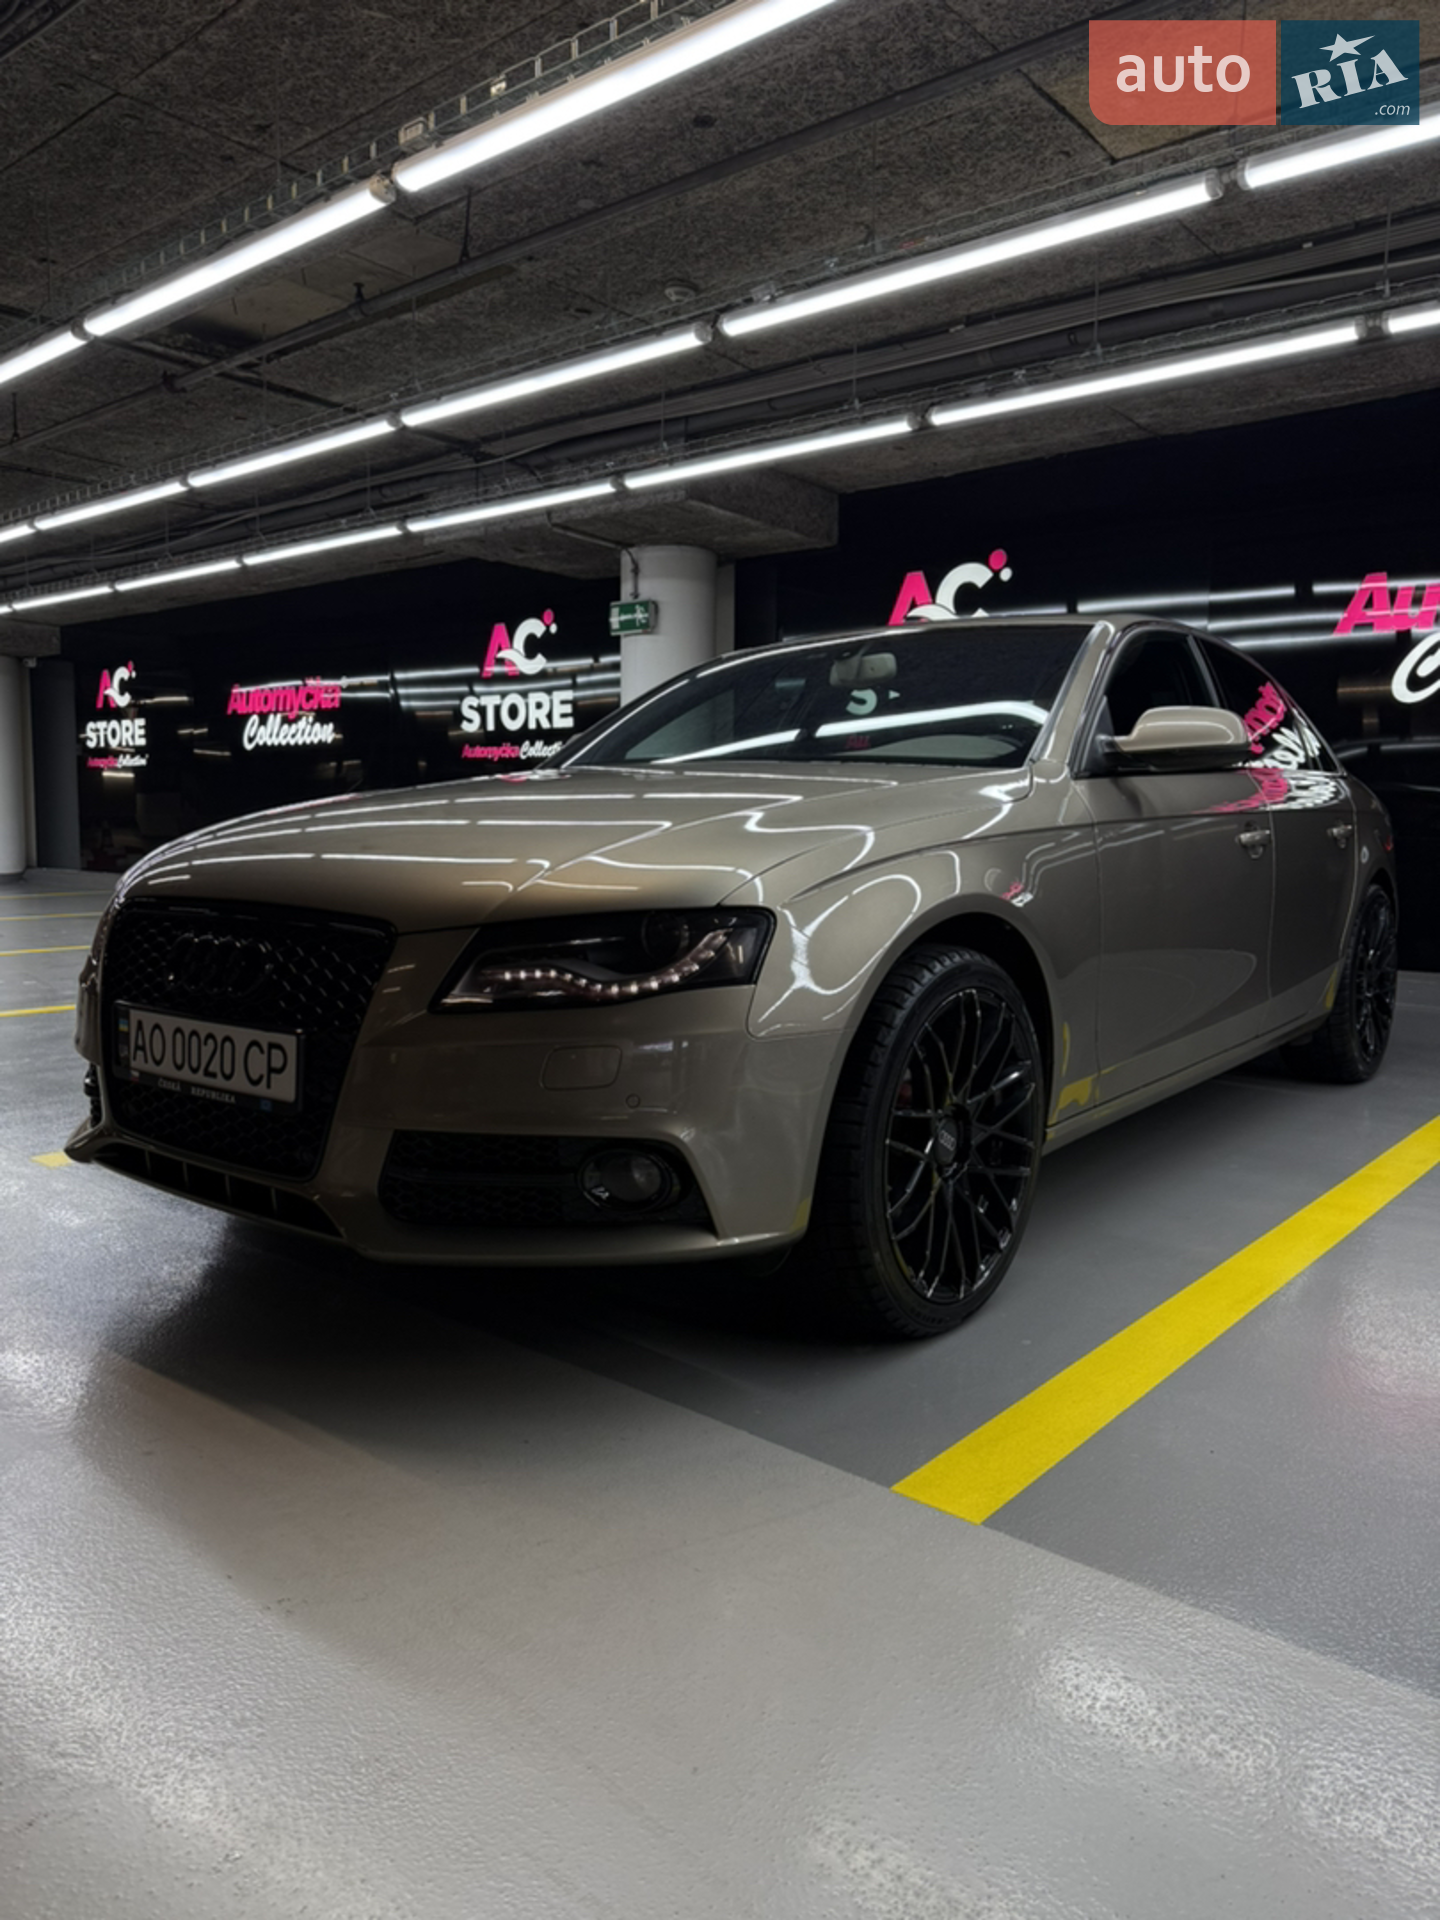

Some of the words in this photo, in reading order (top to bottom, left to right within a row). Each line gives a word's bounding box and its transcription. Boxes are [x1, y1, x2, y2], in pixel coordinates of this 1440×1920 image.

[242, 713, 335, 751] Collection
[459, 689, 575, 734] STORE
[85, 717, 147, 749] STORE
[132, 1019, 166, 1067] AO
[172, 1026, 236, 1081] 0020
[243, 1039, 288, 1090] CP
